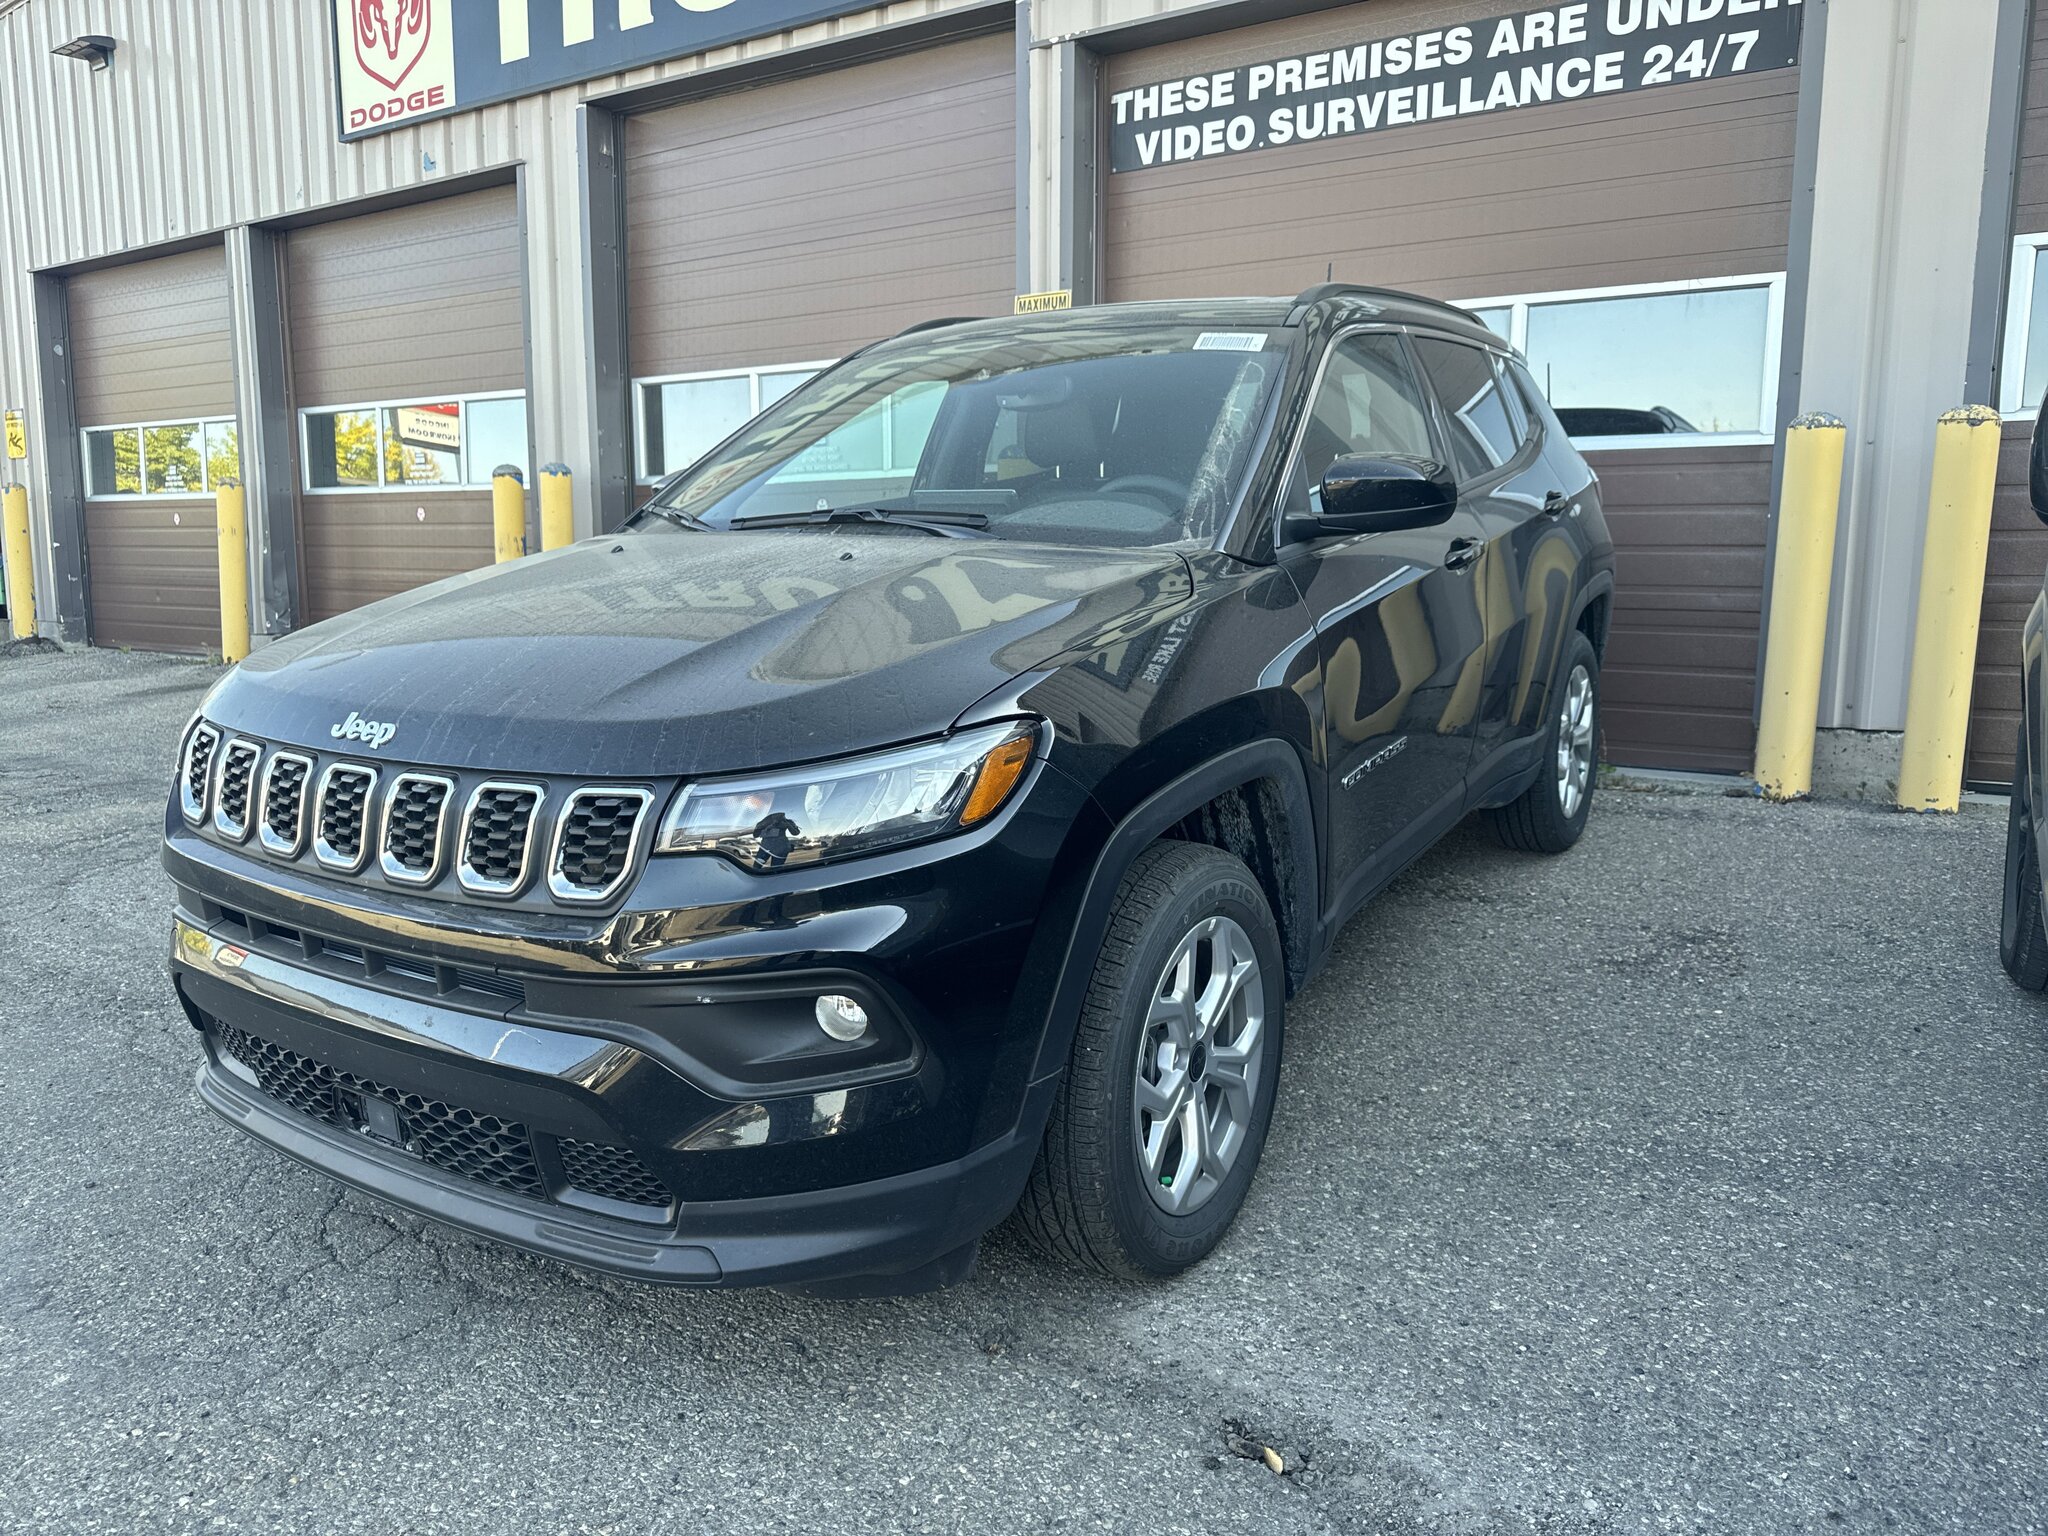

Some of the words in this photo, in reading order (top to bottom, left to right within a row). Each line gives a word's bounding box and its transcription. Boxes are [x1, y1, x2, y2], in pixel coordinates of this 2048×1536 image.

[1111, 71, 1235, 125] THESE
[1248, 26, 1473, 101] PREMISES
[1487, 3, 1588, 58] ARE
[1606, 0, 1803, 36] UND
[350, 84, 445, 129] DODGE
[1135, 115, 1256, 166] VIDEO
[1268, 50, 1625, 145] SURVEILLANCE
[1641, 29, 1760, 86] 24/7
[1018, 295, 1067, 313] MAXIMUM
[330, 711, 397, 750] Jeep
